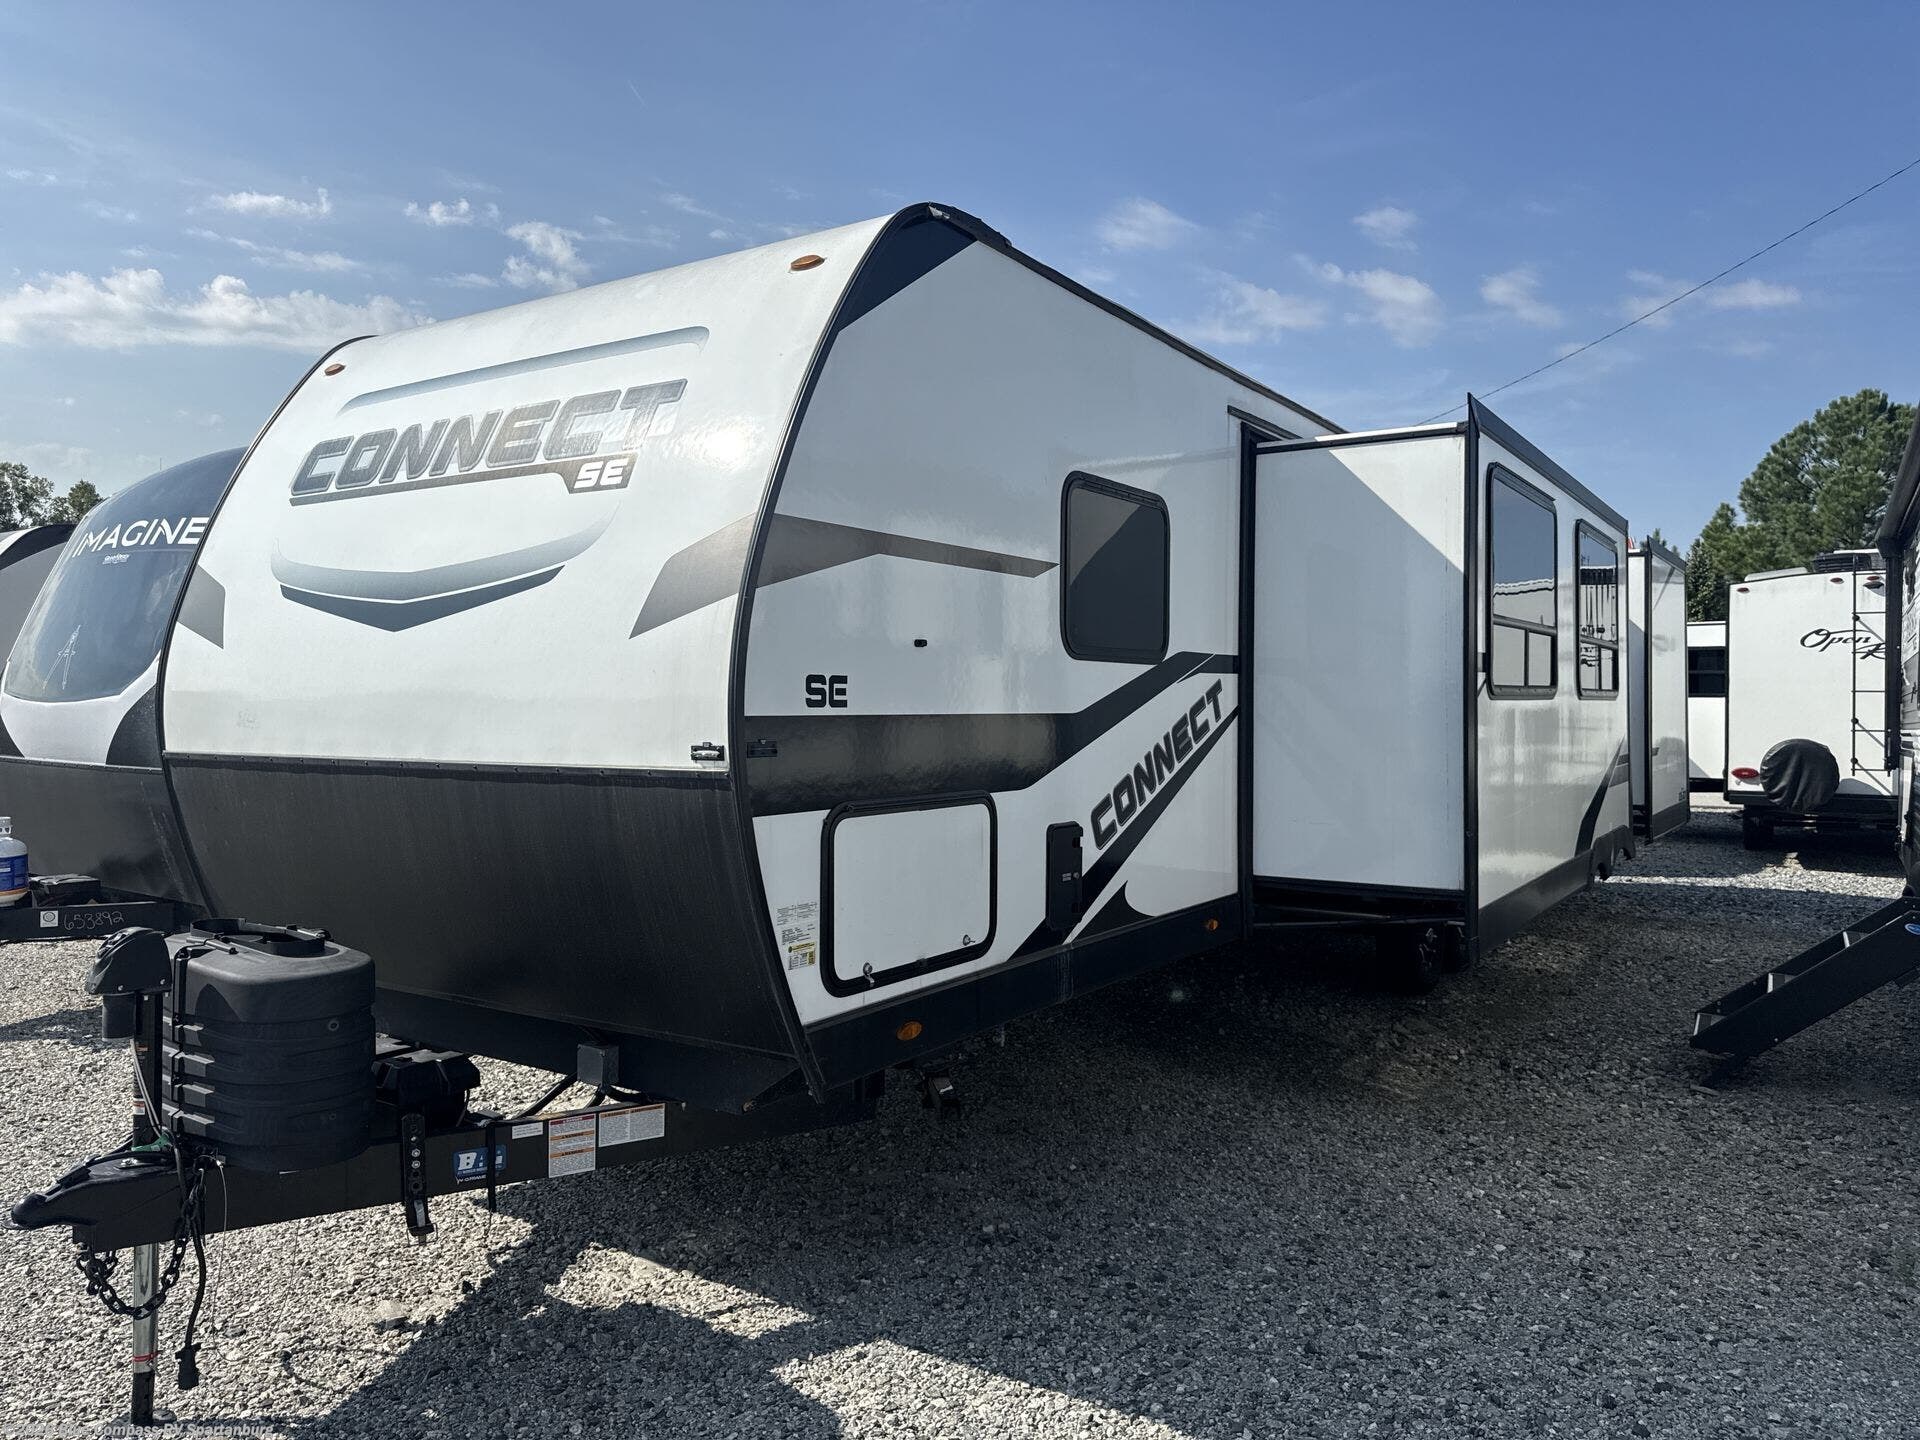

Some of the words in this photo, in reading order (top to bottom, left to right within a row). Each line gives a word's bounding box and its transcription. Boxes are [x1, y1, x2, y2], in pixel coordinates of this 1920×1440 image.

[290, 378, 688, 496] CONNECT
[573, 459, 629, 490] SE
[72, 517, 210, 558] IMAGINE
[1800, 628, 1872, 653] Open
[805, 674, 848, 708] SE
[1090, 678, 1223, 851] CONNECT
[64, 911, 124, 931] 653892
